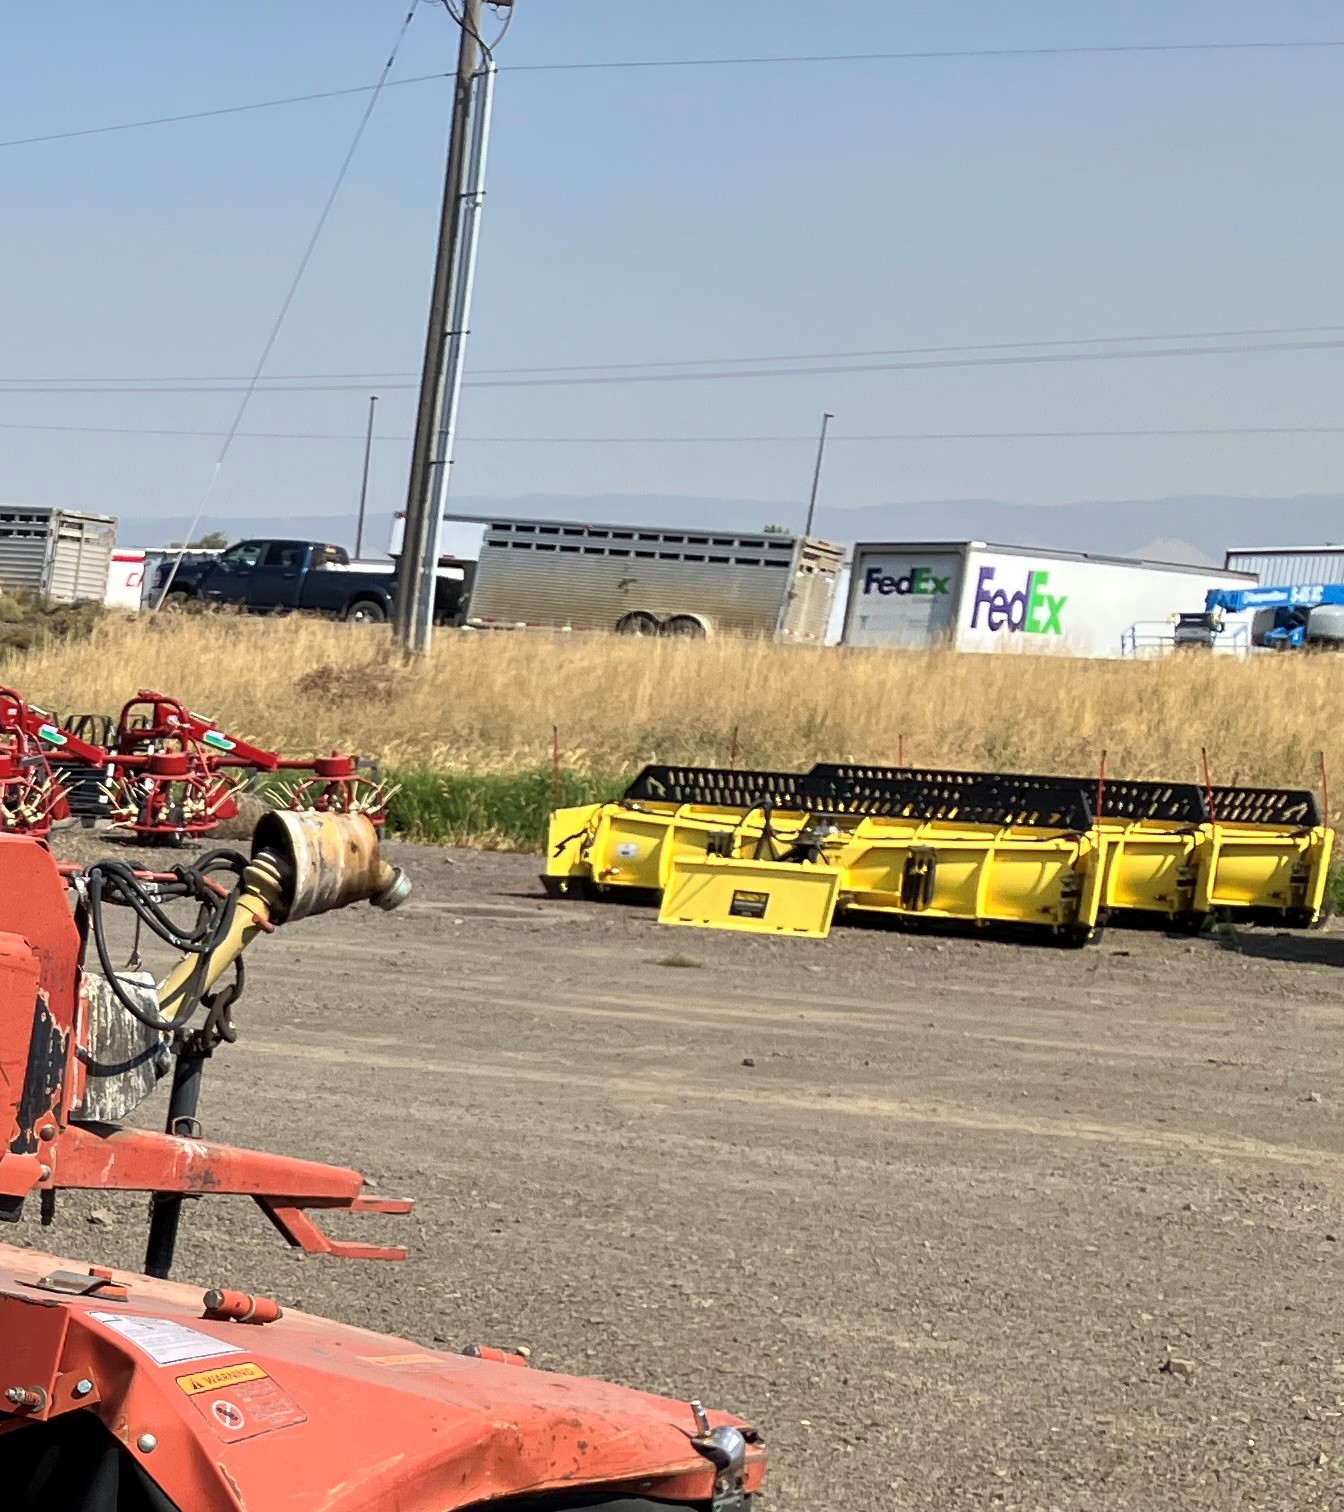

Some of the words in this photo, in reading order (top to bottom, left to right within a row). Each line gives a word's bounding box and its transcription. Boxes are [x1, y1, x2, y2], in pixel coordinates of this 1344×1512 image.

[863, 567, 951, 595] FedEx
[970, 565, 1069, 635] FedEx
[204, 1367, 255, 1386] WARNING
